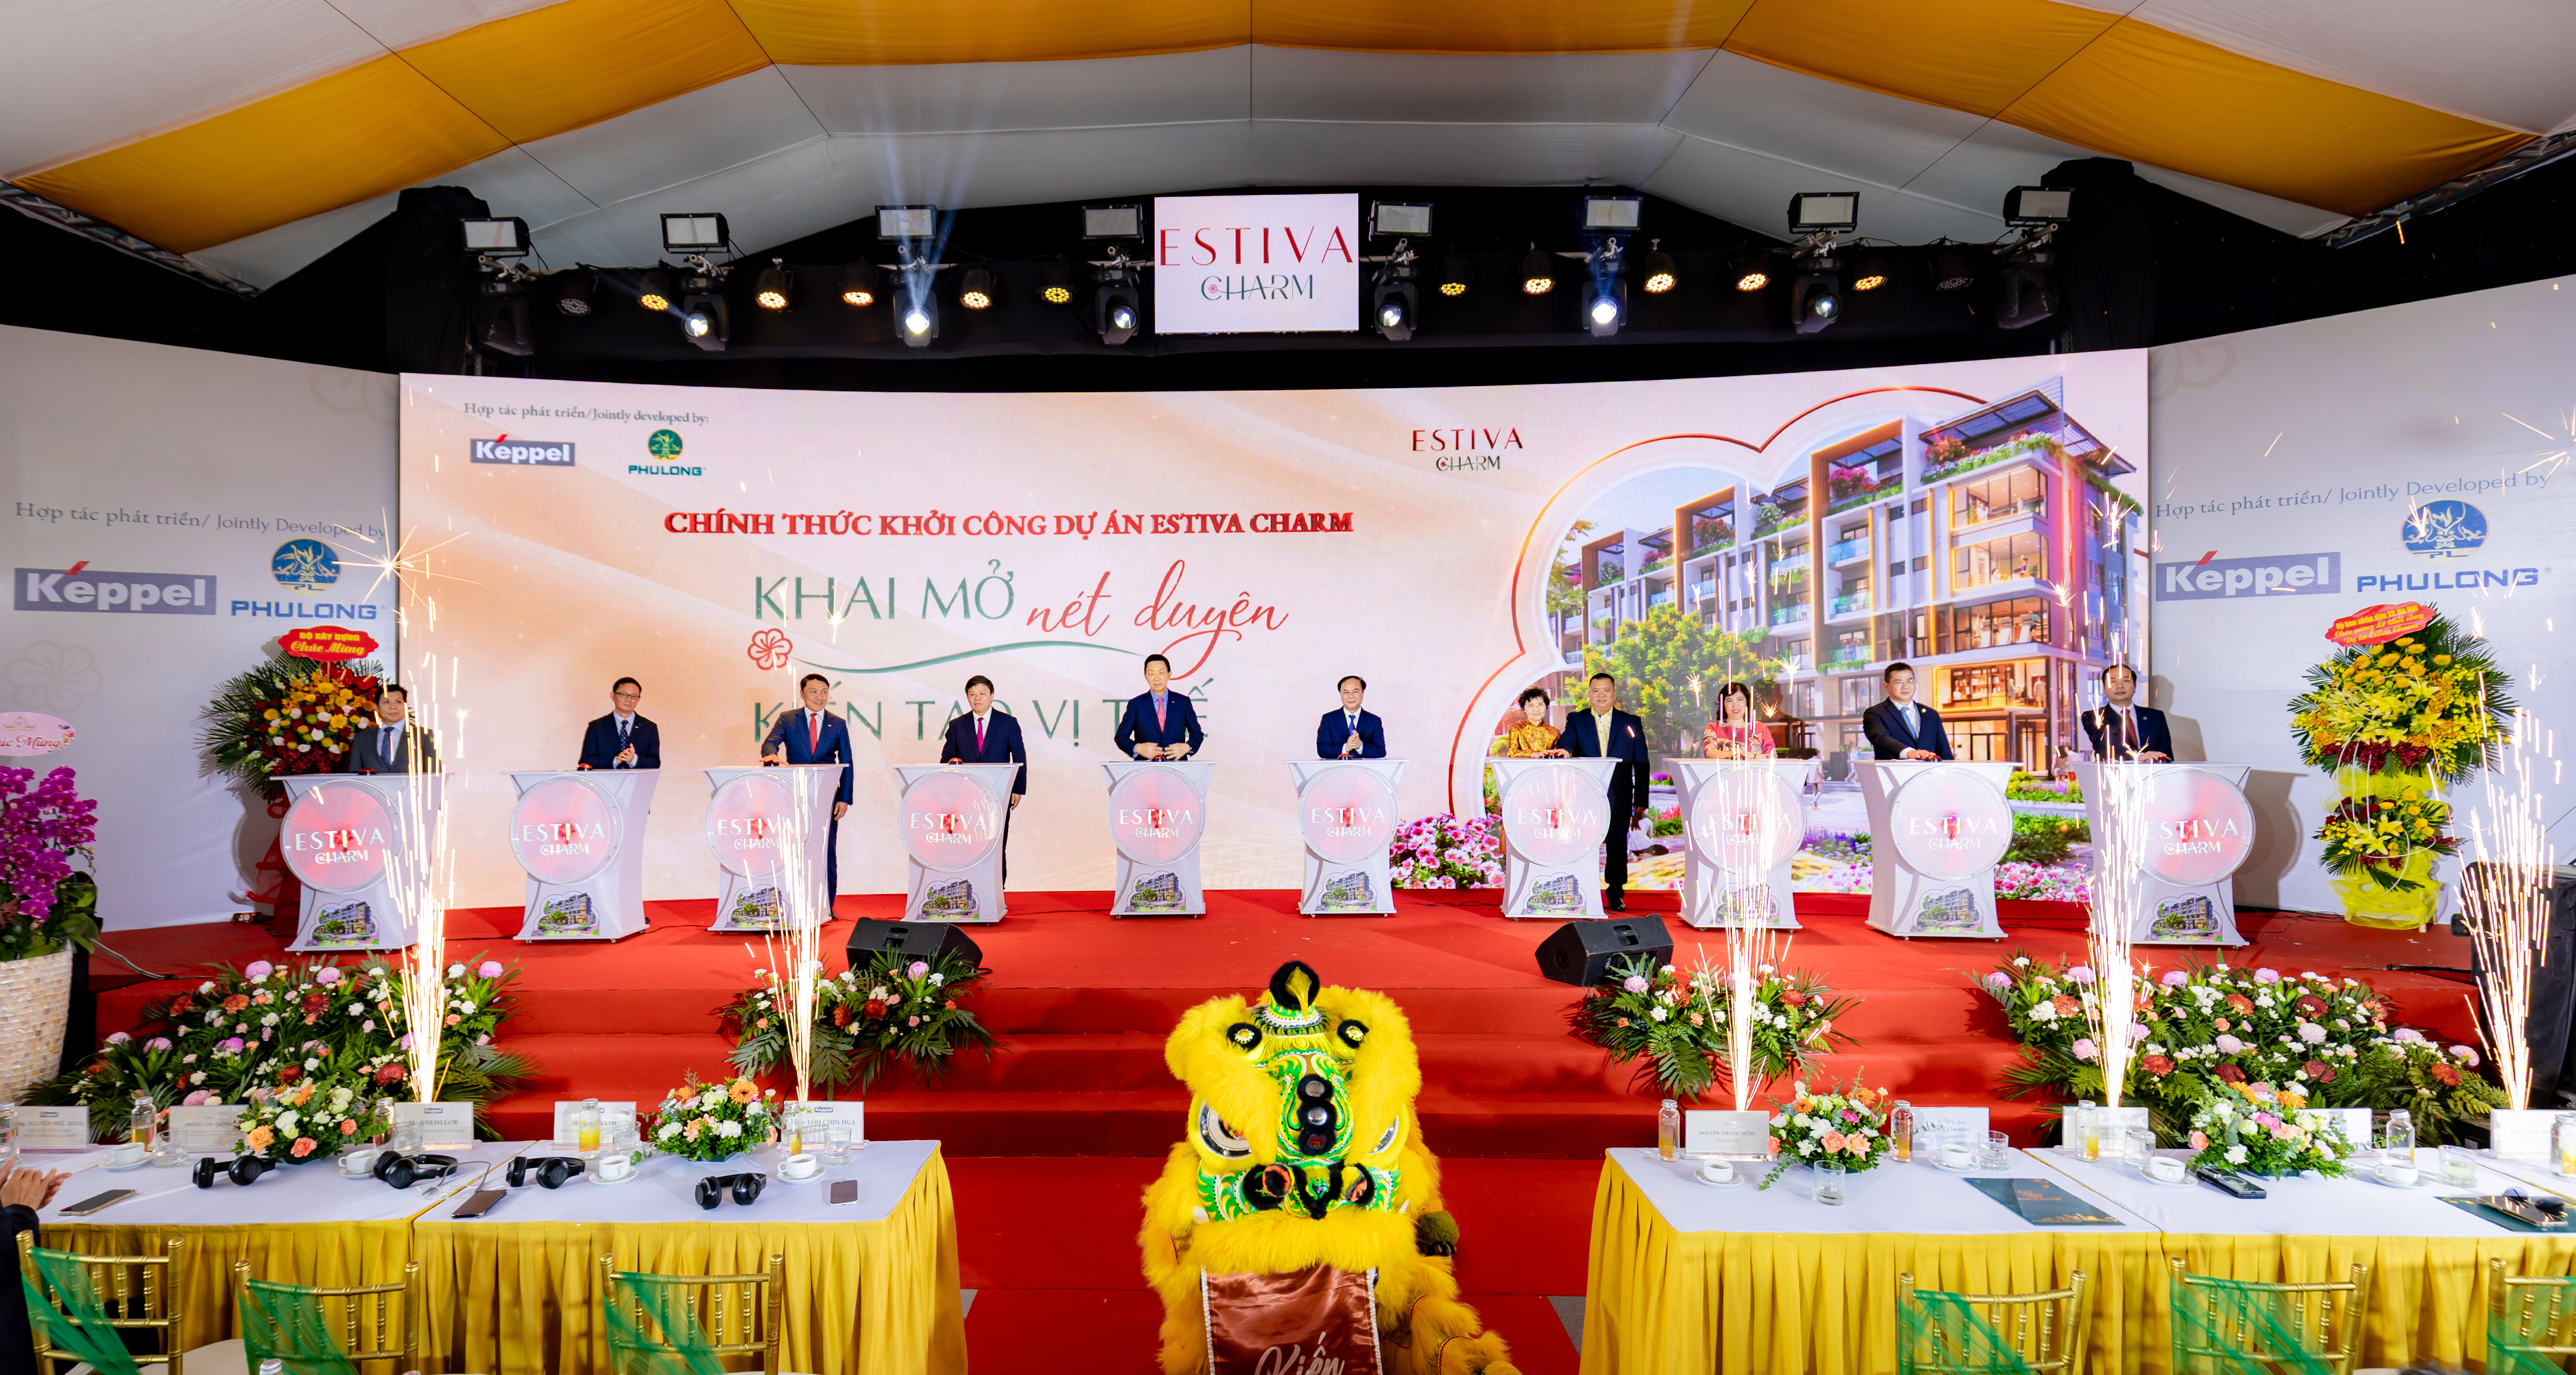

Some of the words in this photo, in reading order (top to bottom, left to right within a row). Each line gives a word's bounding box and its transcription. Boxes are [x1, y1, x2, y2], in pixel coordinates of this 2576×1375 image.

[1160, 225, 1354, 266] ESTIVA
[1201, 274, 1313, 300] CHARM
[464, 403, 494, 417] Hợp
[498, 404, 517, 416] tác
[522, 406, 550, 419] phát
[633, 411, 689, 424] developed
[692, 413, 709, 426] by:
[1412, 428, 1524, 451] ESTIVA
[628, 465, 702, 476] PHULONG
[1436, 455, 1501, 471] CHARM
[2155, 503, 2194, 519] Hợp
[2199, 502, 2225, 514] tác
[2231, 495, 2272, 510] phát
[2277, 488, 2333, 506] triển/
[2338, 484, 2400, 504] Jointly
[2406, 472, 2518, 497] Developed
[2525, 470, 2551, 490] by
[15, 502, 63, 520] Hợp
[71, 506, 98, 522] tác
[106, 508, 149, 526] phát
[156, 512, 210, 528] triển/
[216, 515, 270, 534] Jointly
[276, 518, 364, 538] Developed
[368, 525, 386, 540] by
[664, 508, 774, 534] CHÍNH
[781, 510, 872, 535] THỨC
[878, 509, 956, 536] KHỞI
[962, 510, 1047, 535] CÔNG
[1053, 511, 1098, 540] DỰ
[1101, 510, 1144, 535] ÁN
[1150, 512, 1245, 534] ESTIVA
[1249, 512, 1354, 533] CHARM
[2357, 568, 2539, 593] PHULONG
[231, 601, 377, 620] PHULONG
[2345, 619, 2357, 627] ban
[2357, 616, 2374, 625] nhân
[2374, 612, 2387, 620] dân
[2406, 604, 2419, 612] Nội
[2406, 613, 2424, 622] công
[755, 576, 895, 620] KHAI
[921, 559, 1013, 620] MỞ
[1026, 571, 1112, 636] nét
[1133, 560, 1289, 681] duyên
[335, 633, 360, 642] DỰNG
[2369, 629, 2391, 639] Estiva
[2393, 623, 2418, 633] Charm
[291, 641, 323, 651] Chúc
[325, 642, 364, 656] Mừng
[755, 681, 881, 742] KN
[1032, 700, 1079, 747] VỊ
[1102, 678, 1214, 739] TẾ
[911, 813, 986, 830] ESTIVA
[1120, 809, 1194, 825] ESTIVA
[1311, 807, 1386, 823] ESTIVA
[1518, 808, 1595, 824] ESTIVA
[1709, 813, 1792, 830] ESTIA
[523, 822, 606, 841] ESTIVA
[718, 817, 796, 835] ESTIVA
[1135, 827, 1179, 838] CHARM
[1327, 826, 1371, 837] CHARM
[1909, 816, 1998, 834] ESTIVA
[2144, 818, 2240, 840] ESTIVA
[295, 827, 386, 850] ESTIVA
[734, 838, 779, 849] CHARM
[926, 832, 971, 844] CHARM
[1928, 838, 1981, 849] CHARM
[540, 843, 589, 856] CHARM
[2164, 840, 2221, 855] CHARM
[315, 849, 369, 864] CHARM
[1255, 1331, 1345, 1375] Kiến
